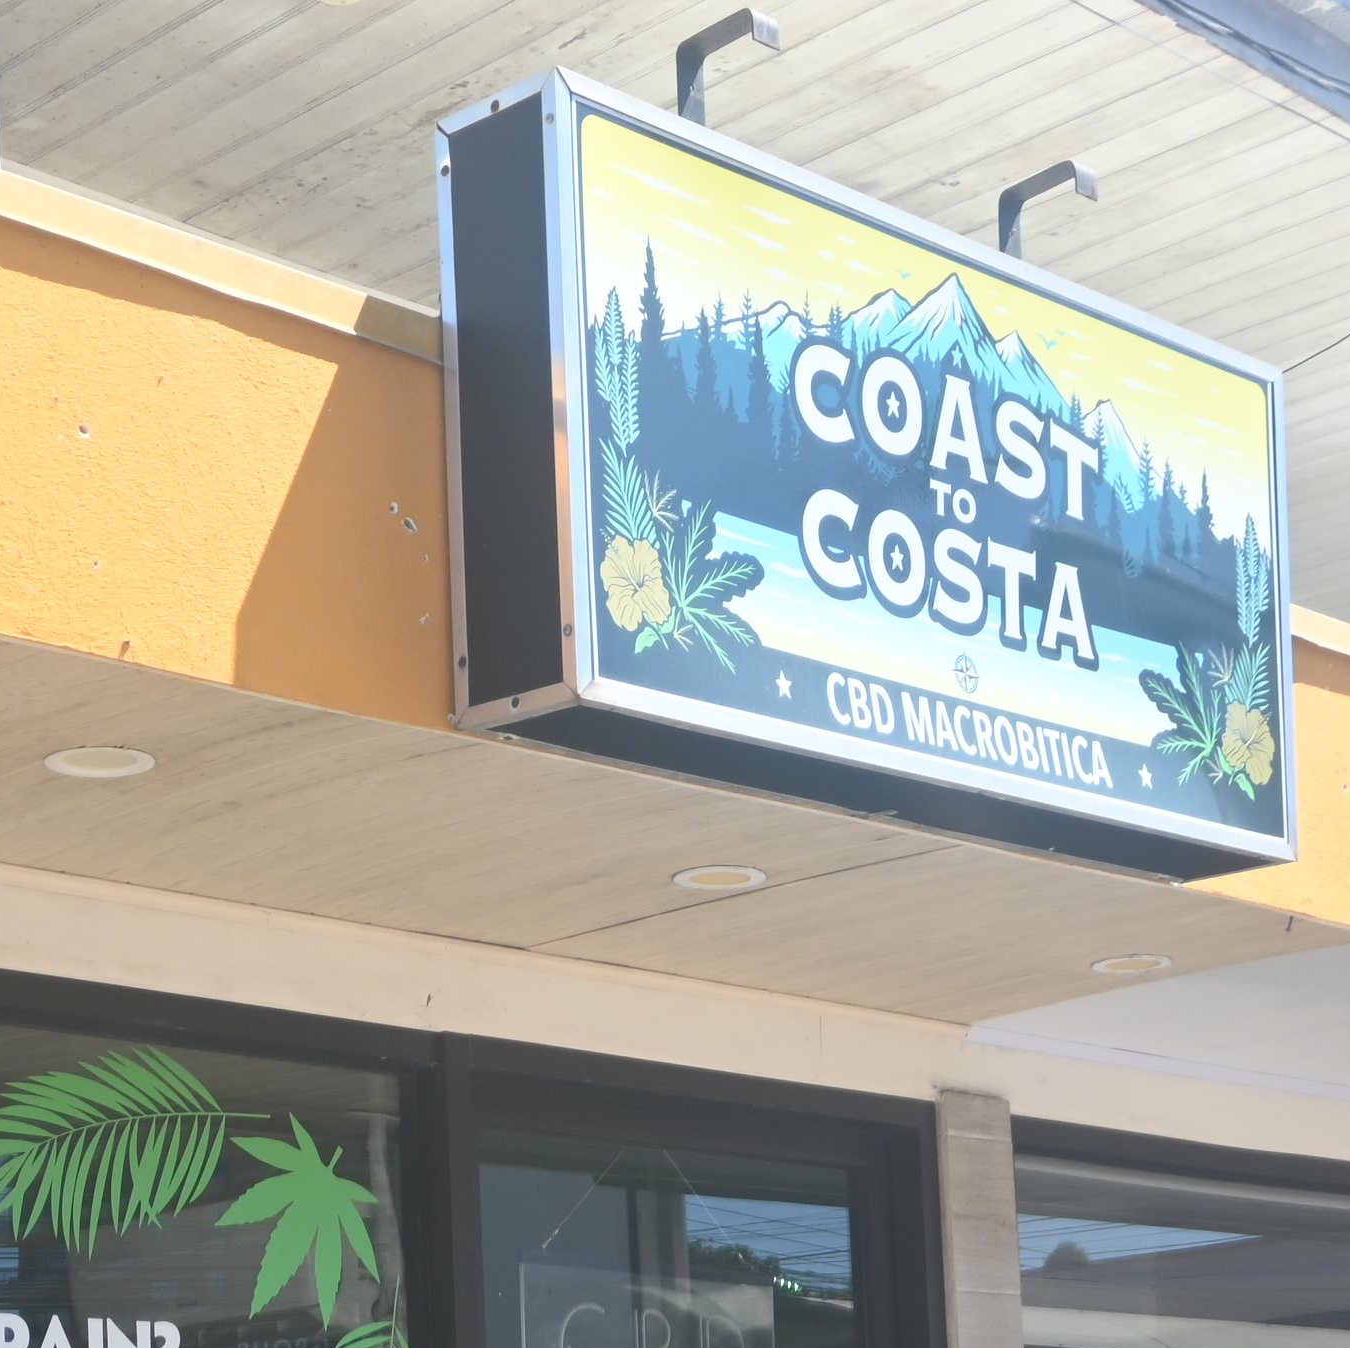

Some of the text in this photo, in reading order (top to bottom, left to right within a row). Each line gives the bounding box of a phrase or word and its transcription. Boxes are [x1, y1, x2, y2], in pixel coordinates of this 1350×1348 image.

[794, 344, 1099, 521] COAST
[929, 478, 977, 524] TO
[802, 488, 1095, 660] COSTA
[826, 671, 1114, 789] CBD MACROBITICA
